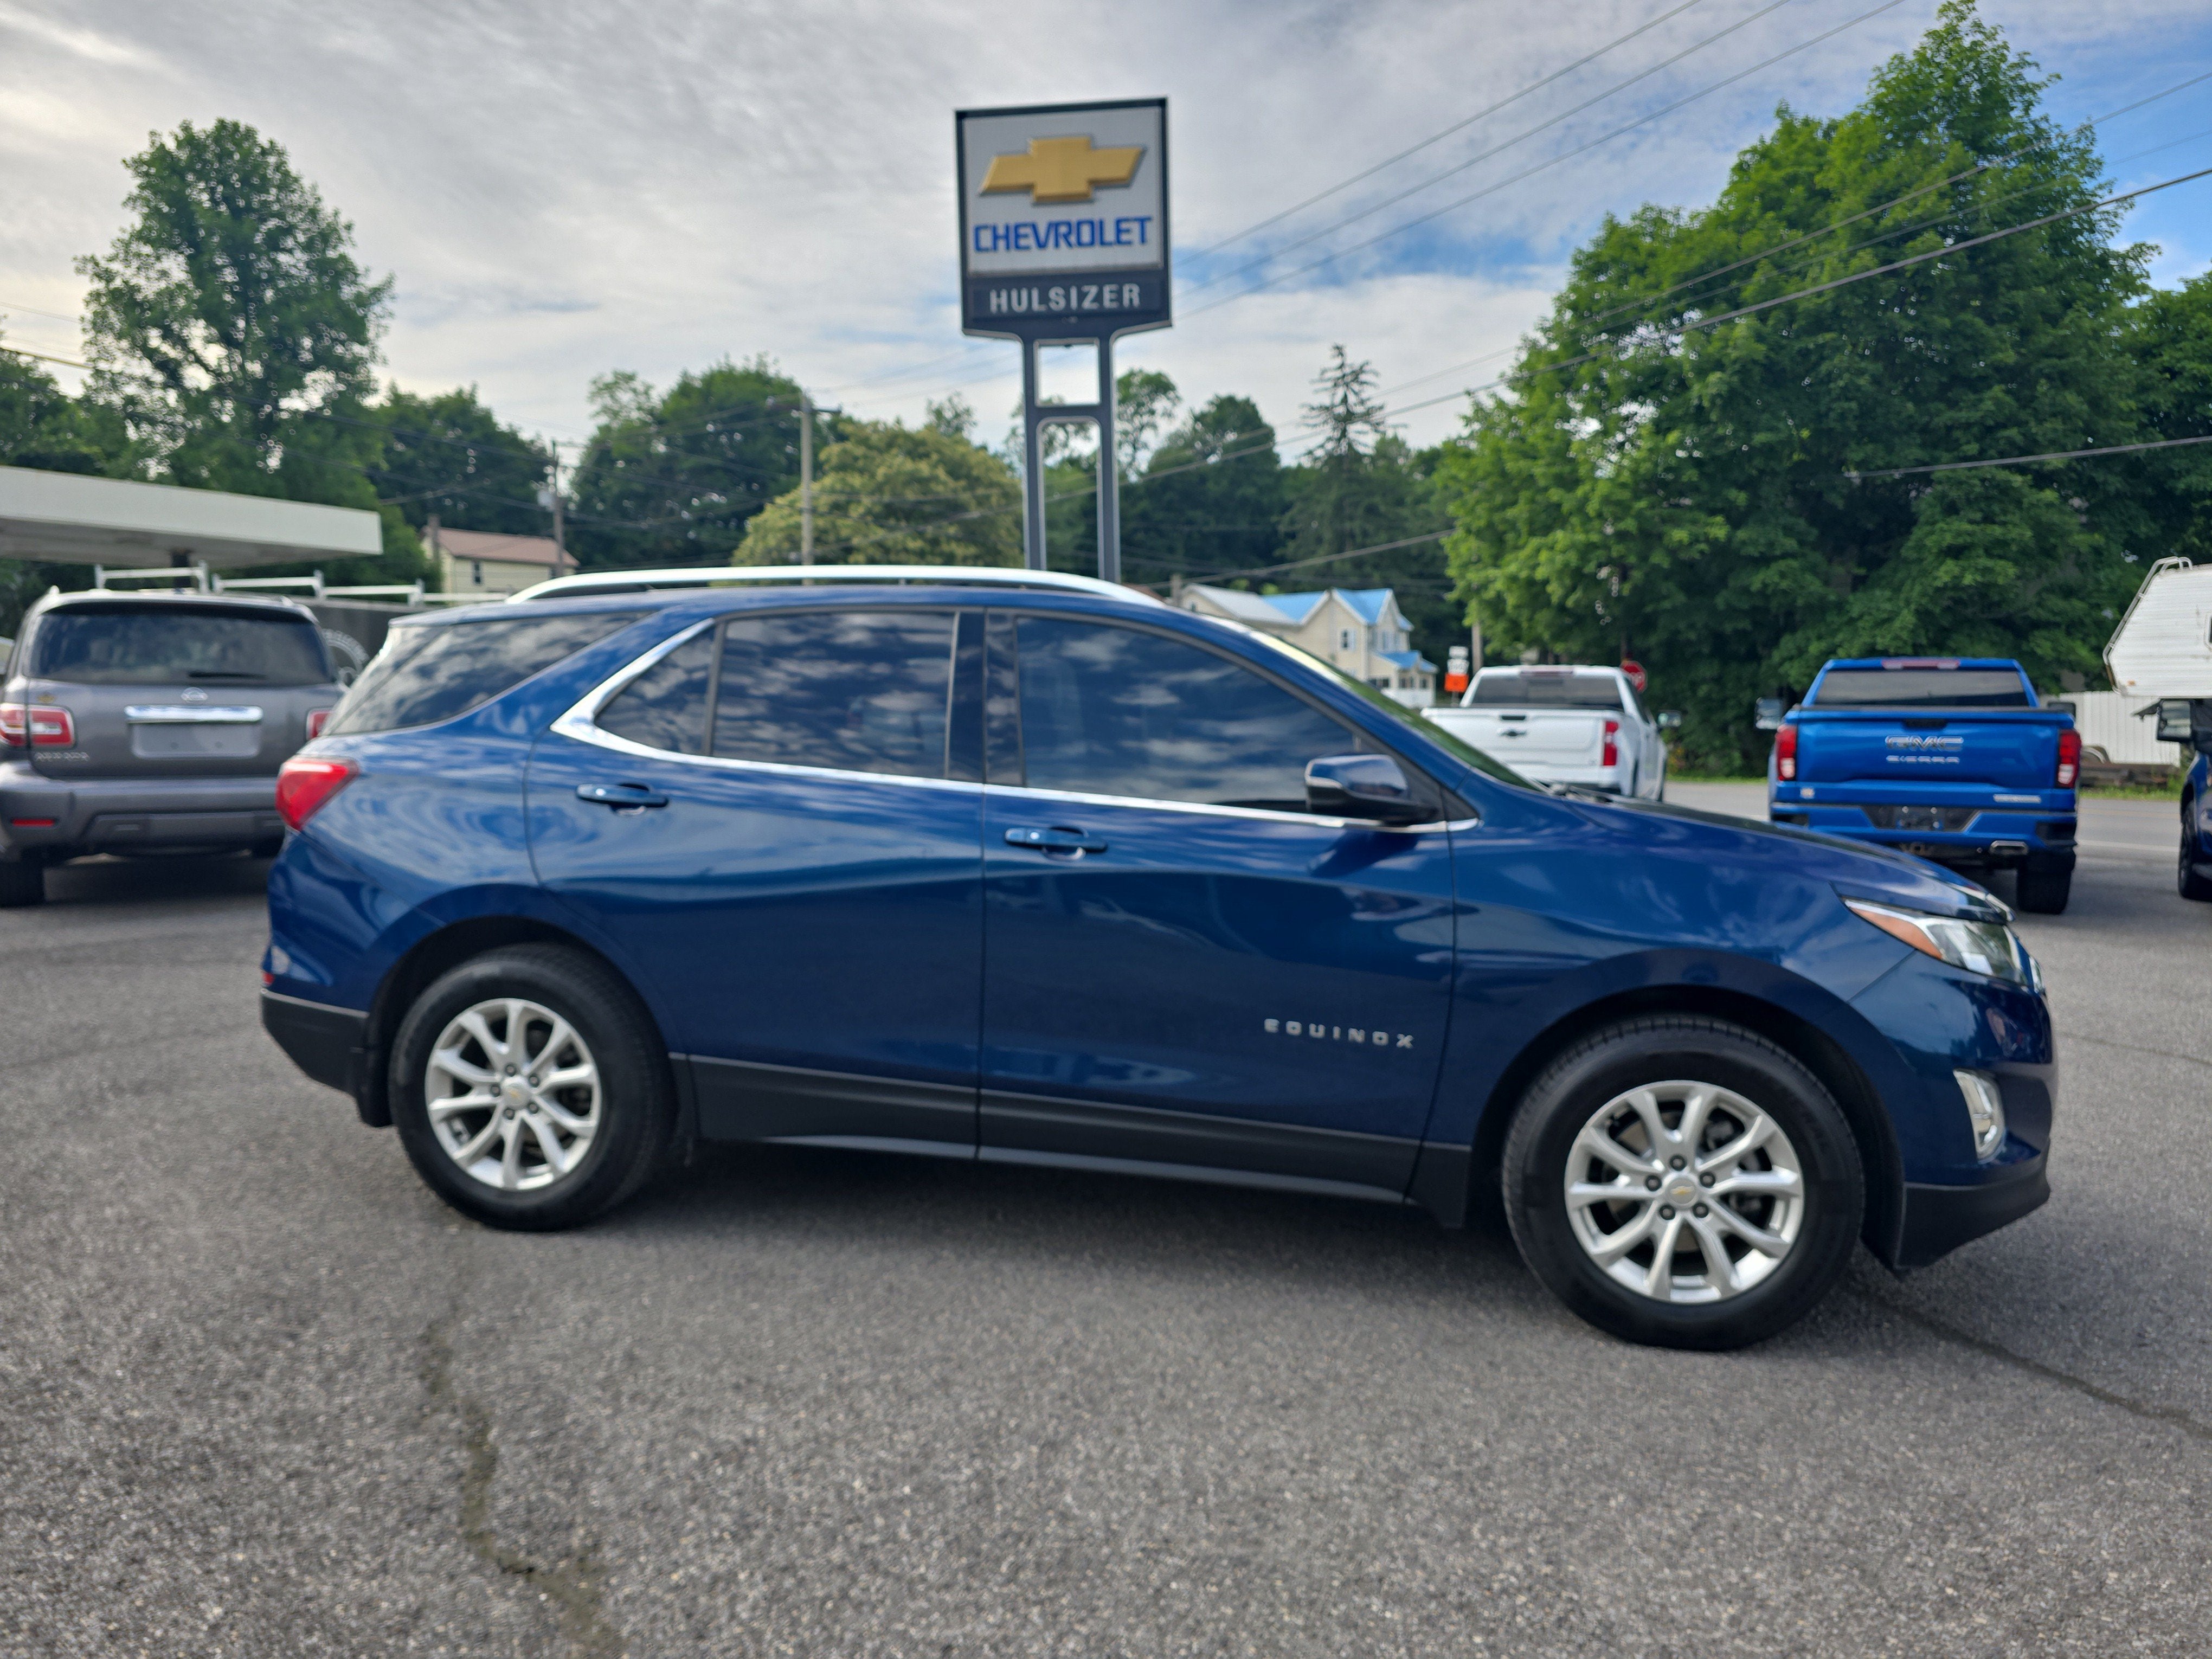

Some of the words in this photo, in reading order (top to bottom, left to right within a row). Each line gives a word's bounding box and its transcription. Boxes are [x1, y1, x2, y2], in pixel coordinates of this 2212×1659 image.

[974, 216, 1152, 253] CHEVROLET
[989, 283, 1141, 314] HULSIZER
[1885, 736, 1964, 751] GMC
[1264, 1018, 1413, 1049] EQUINOX
